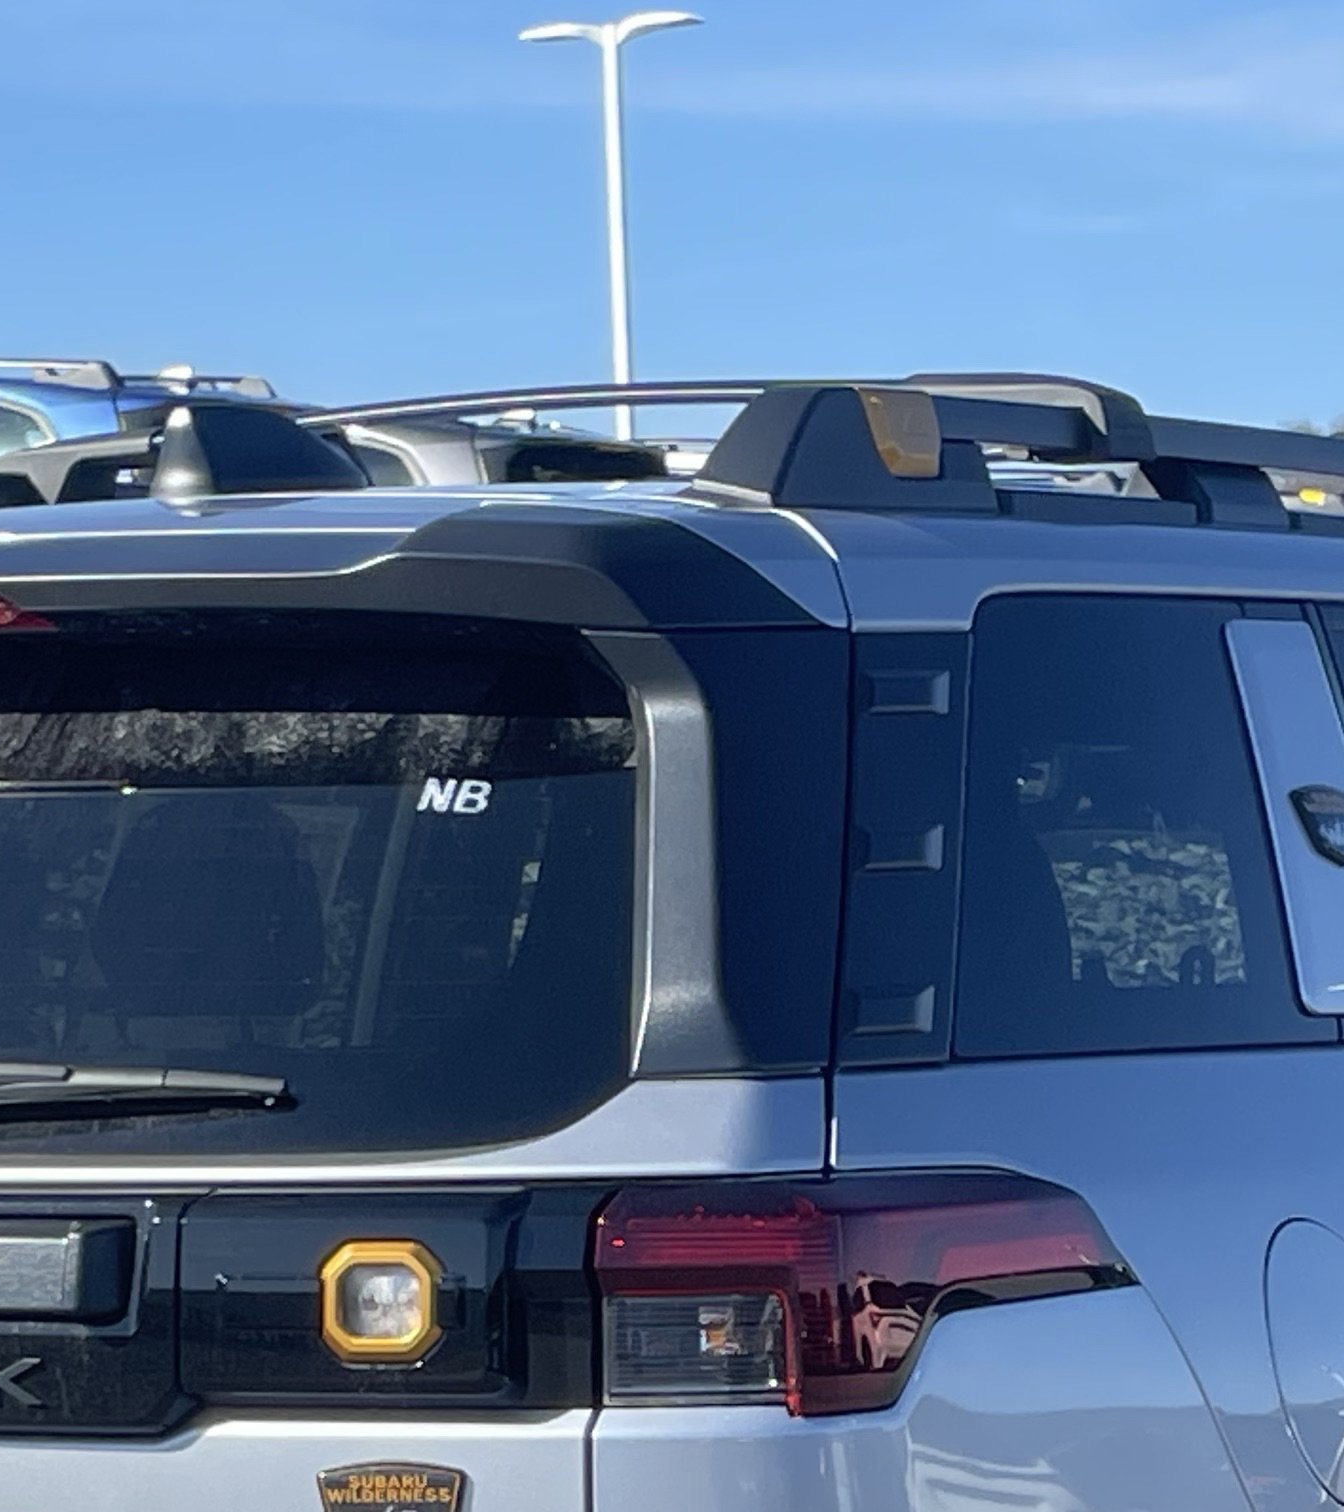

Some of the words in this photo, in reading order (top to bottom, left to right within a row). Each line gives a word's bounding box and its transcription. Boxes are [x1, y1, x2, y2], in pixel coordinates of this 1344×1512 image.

[416, 777, 492, 814] NB
[348, 1473, 428, 1488] SUBARU
[326, 1487, 453, 1503] WILDERNESS
